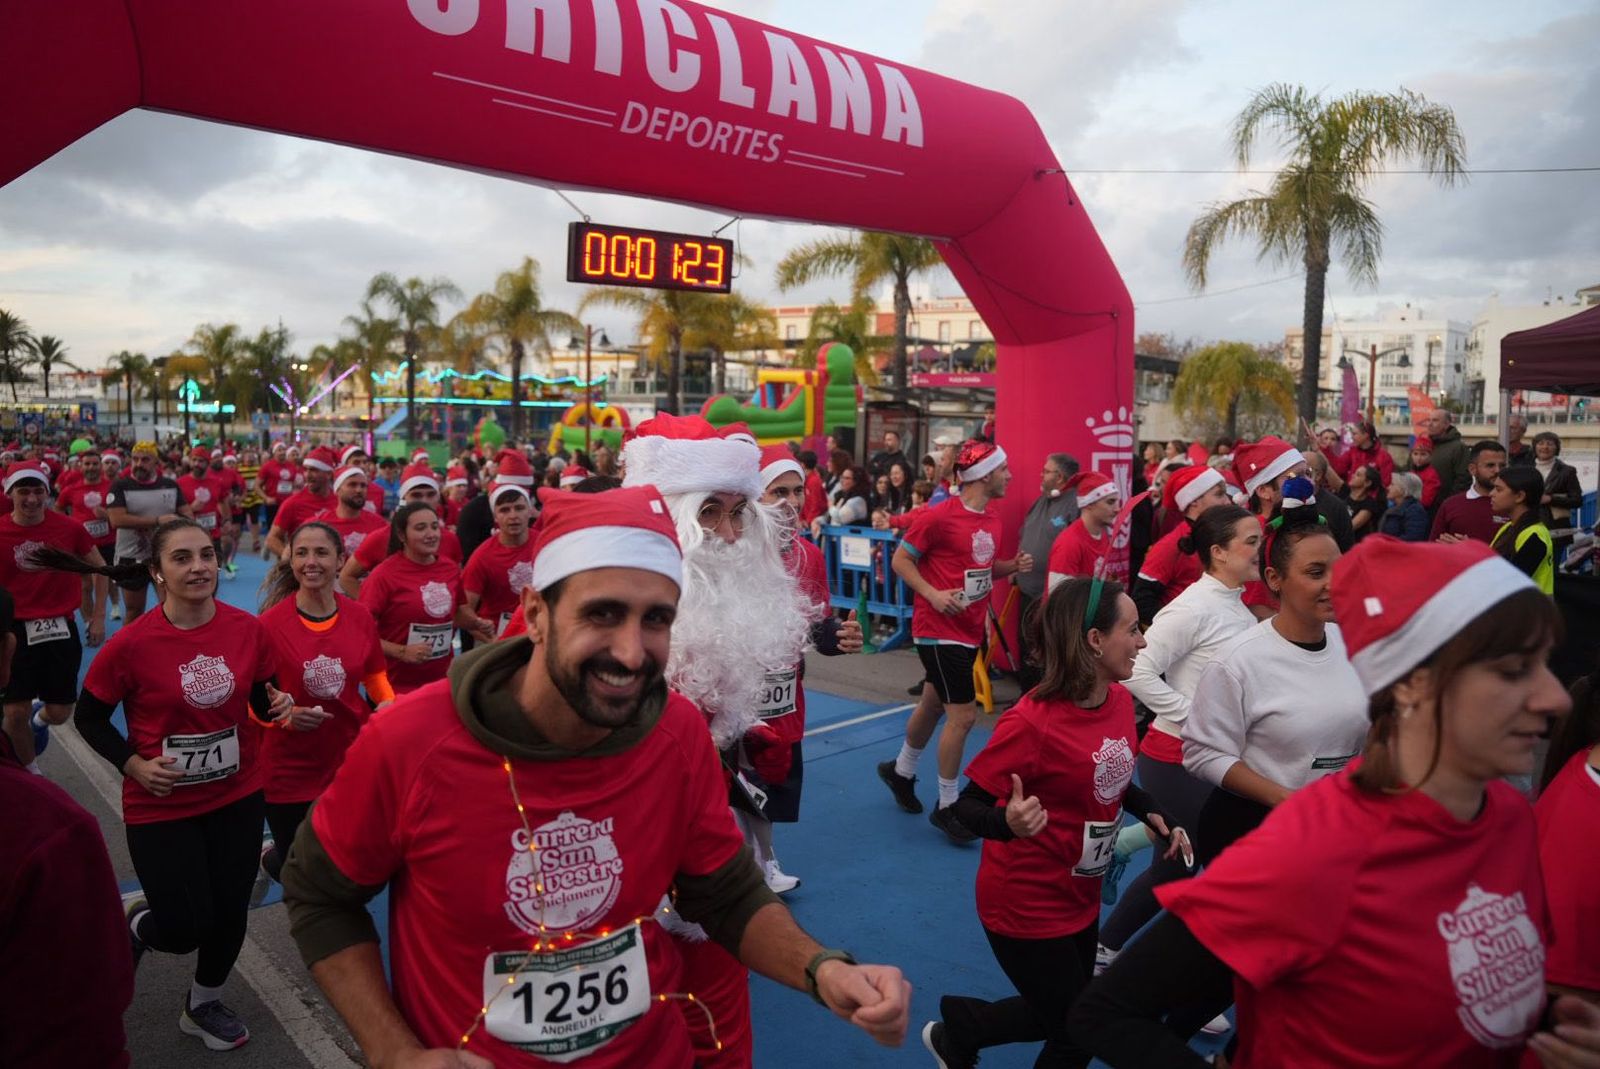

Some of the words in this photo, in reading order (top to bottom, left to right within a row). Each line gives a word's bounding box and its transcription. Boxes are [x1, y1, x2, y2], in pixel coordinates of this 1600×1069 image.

[620, 100, 784, 163] DEPORTES
[34, 619, 59, 632] 234
[178, 655, 225, 675] Carrera
[194, 668, 220, 682] San
[182, 672, 236, 695] Silvestre
[181, 744, 224, 770] 771
[1091, 736, 1129, 764] Carrera
[1106, 752, 1127, 773] San
[511, 816, 616, 853] Carrera
[541, 846, 596, 872] San
[508, 857, 625, 904] Silvestre
[1437, 891, 1528, 943] Carrera
[1473, 926, 1525, 966] San
[512, 963, 630, 1025] 1256
[540, 1016, 588, 1035] ANDREU
